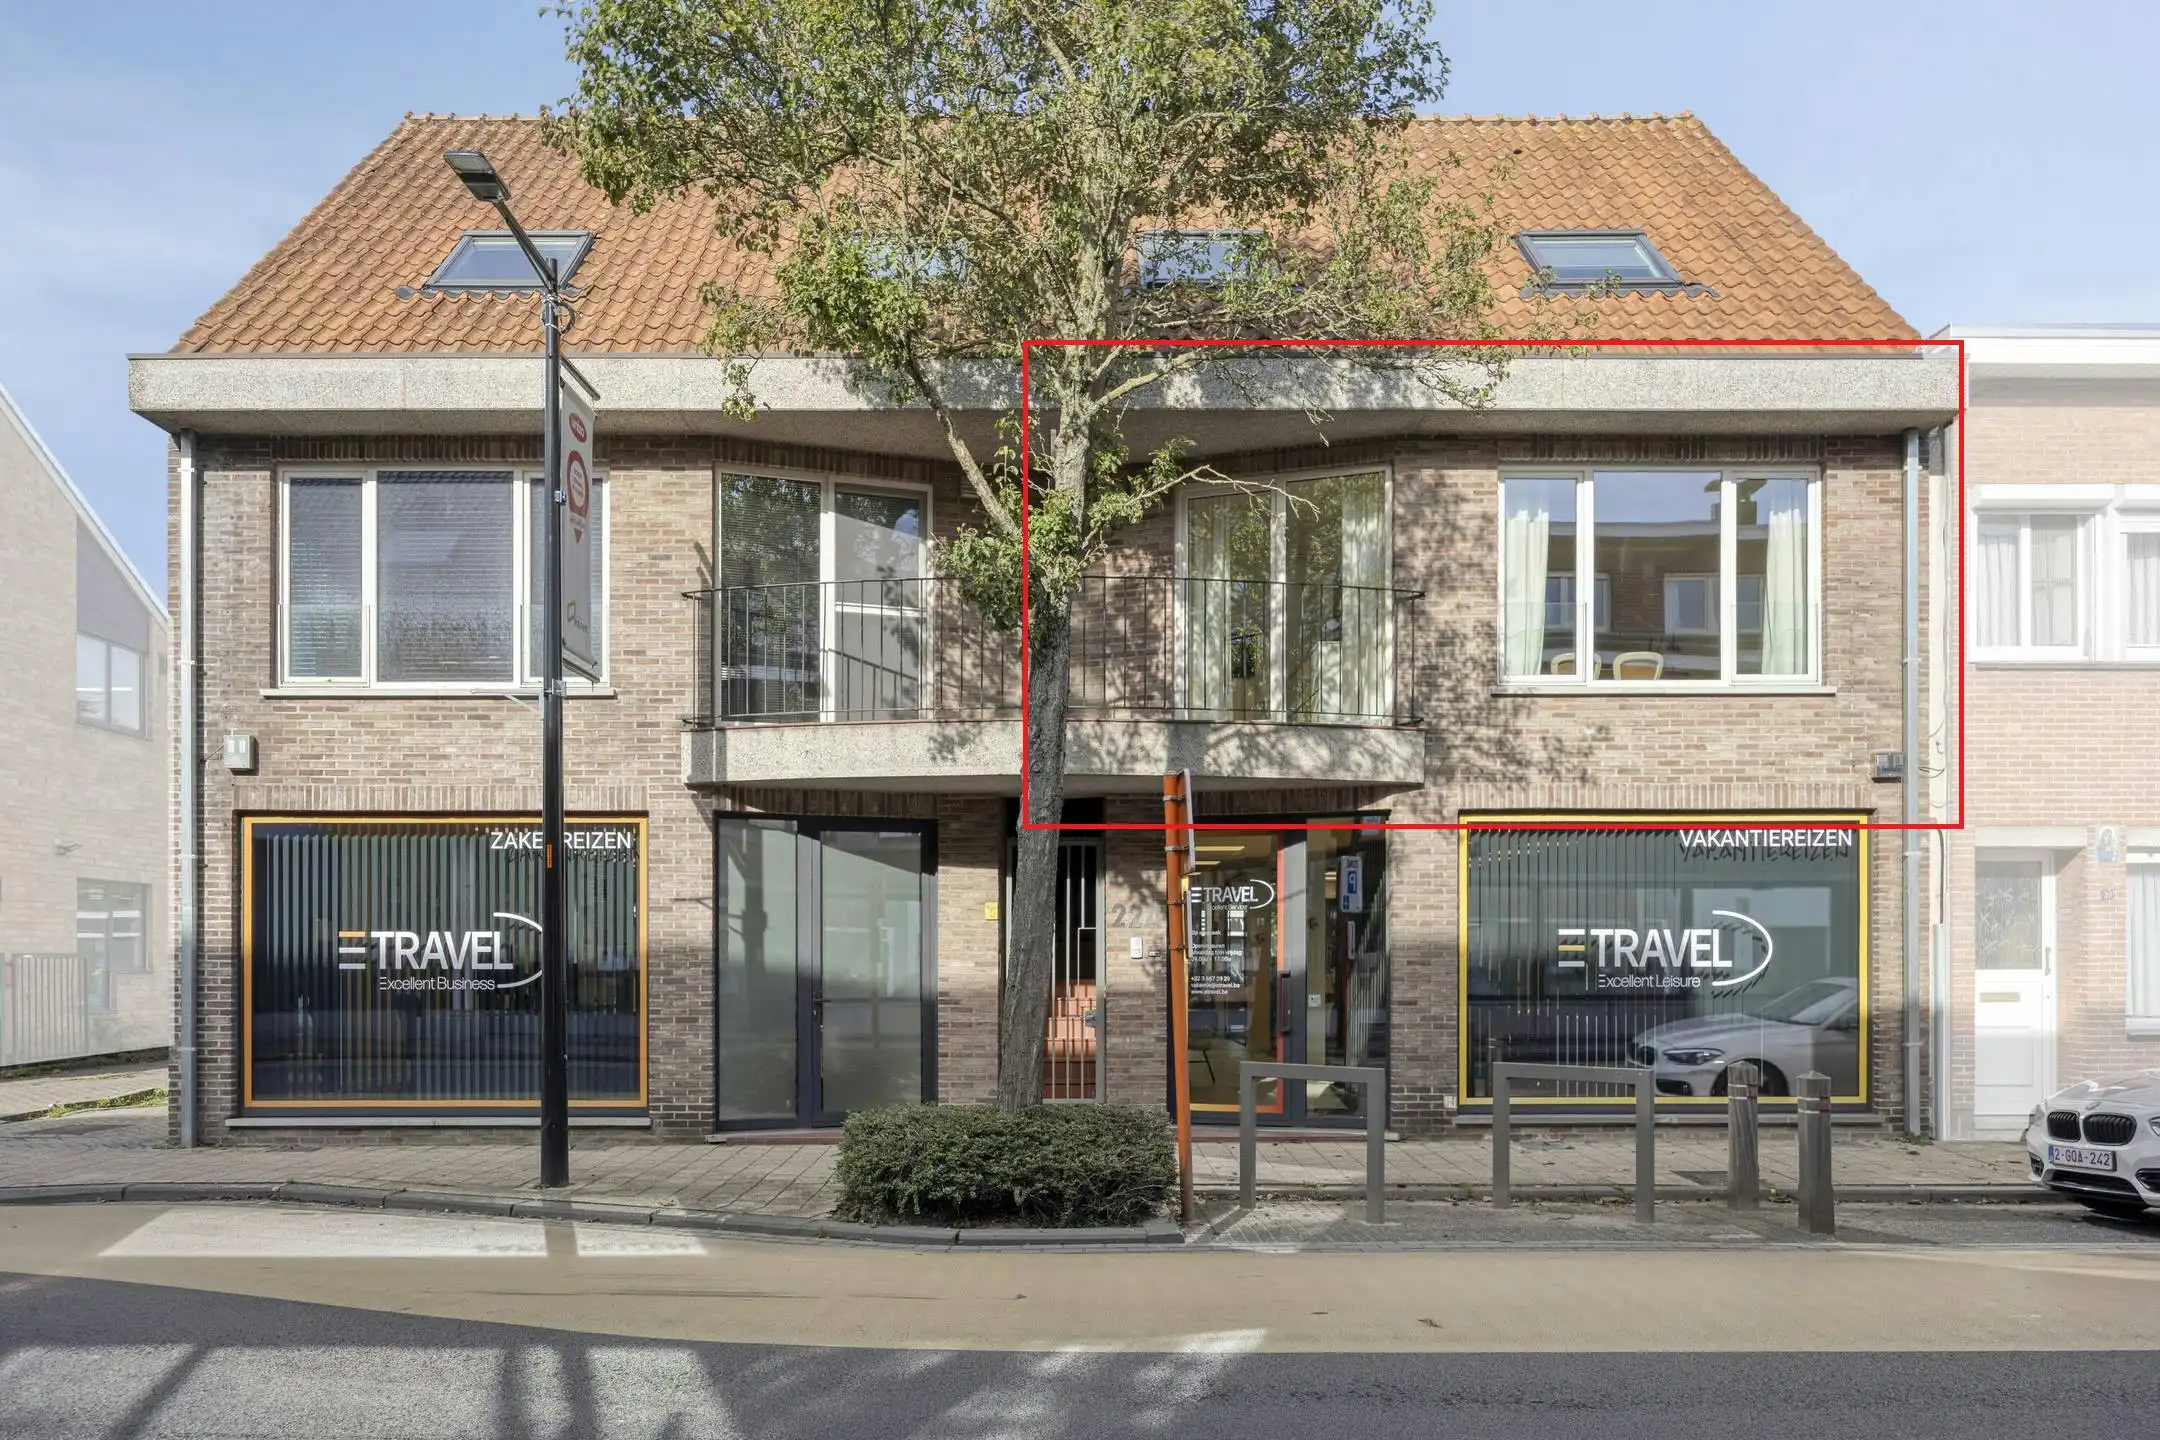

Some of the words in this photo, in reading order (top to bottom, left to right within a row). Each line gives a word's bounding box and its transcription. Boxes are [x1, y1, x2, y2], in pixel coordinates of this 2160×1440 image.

[491, 832, 631, 849] ZAKEREIZEN
[1680, 829, 1852, 847] VAKANTIEREIZEN
[339, 931, 513, 970] ETRAVEL
[1558, 929, 1732, 967] ETRAVEL
[379, 976, 435, 990] Excellent
[437, 976, 495, 990] Business
[1598, 974, 1654, 988] Excellent
[1656, 974, 1701, 988] Leisure
